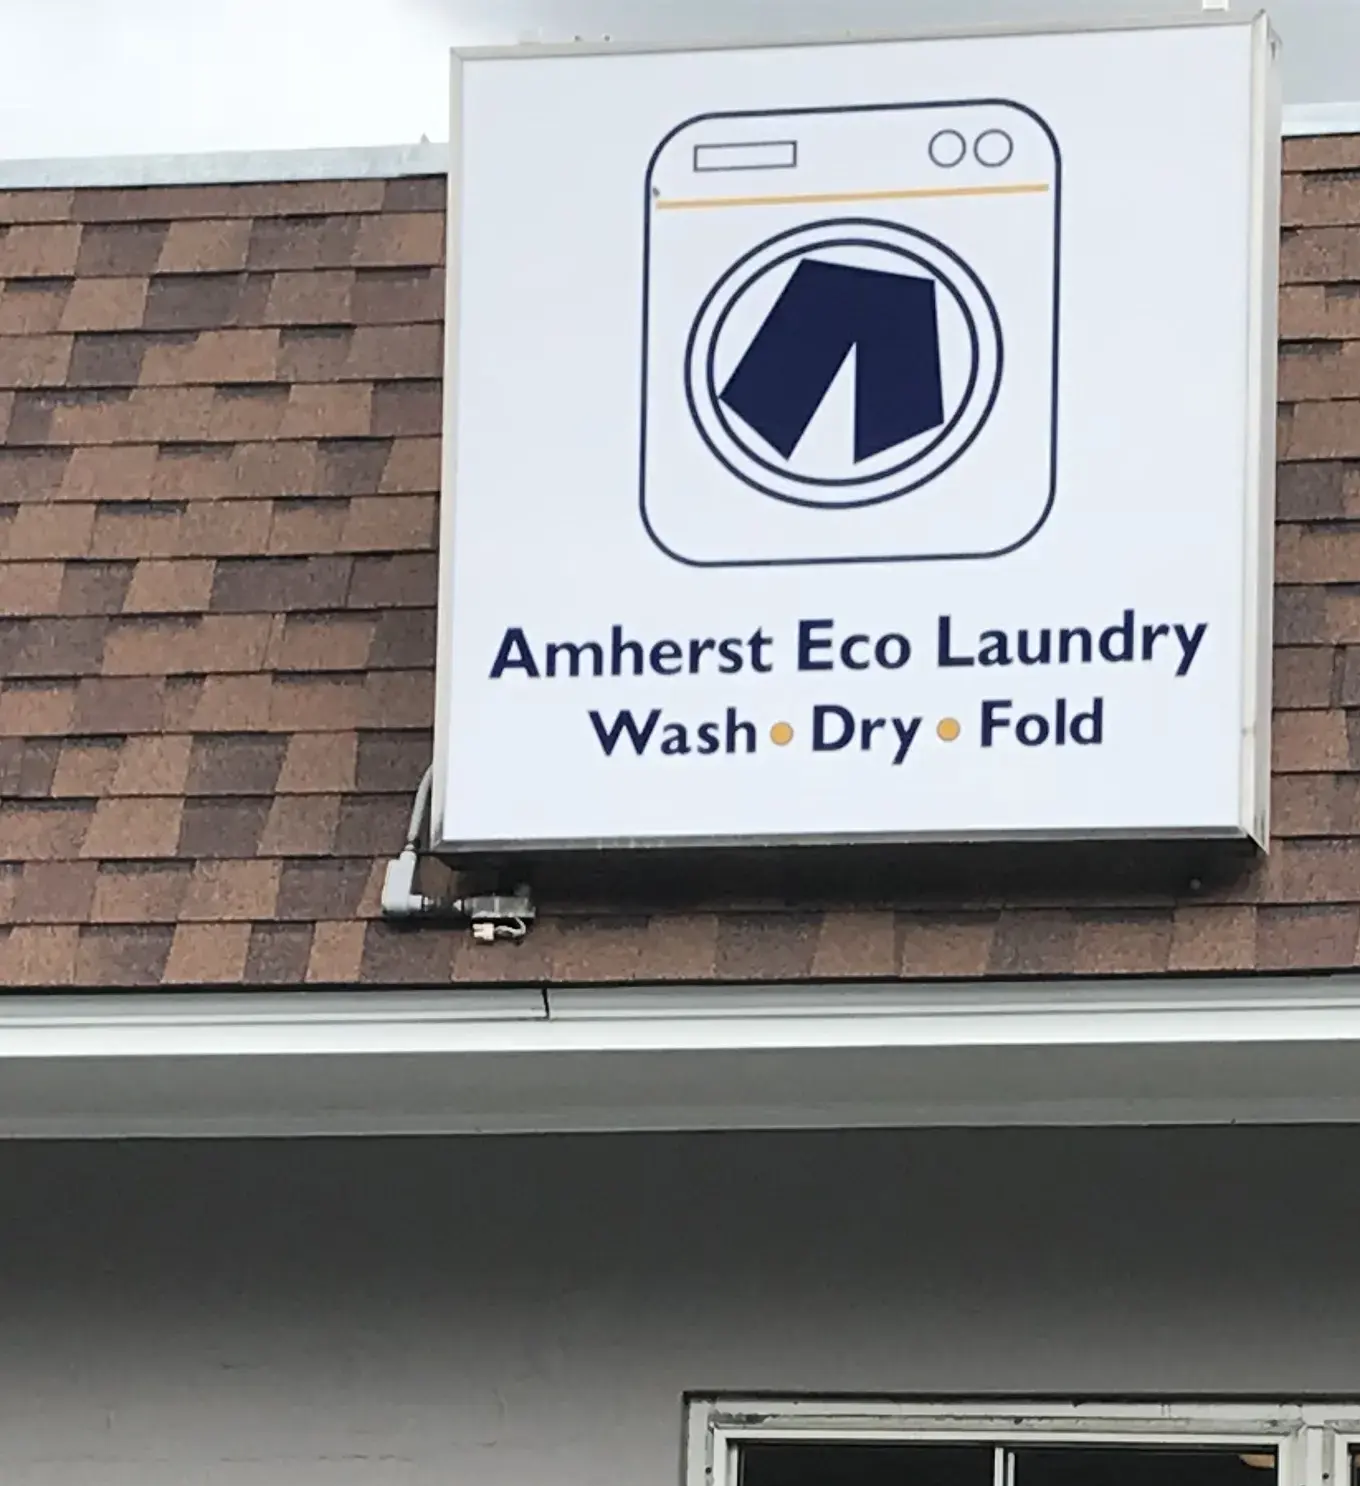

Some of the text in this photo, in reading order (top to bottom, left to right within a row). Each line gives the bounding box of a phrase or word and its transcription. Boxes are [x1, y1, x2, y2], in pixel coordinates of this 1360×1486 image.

[488, 609, 1208, 680] Amherst Eco Laundry
[588, 697, 1104, 765] Wash Dry Fold
